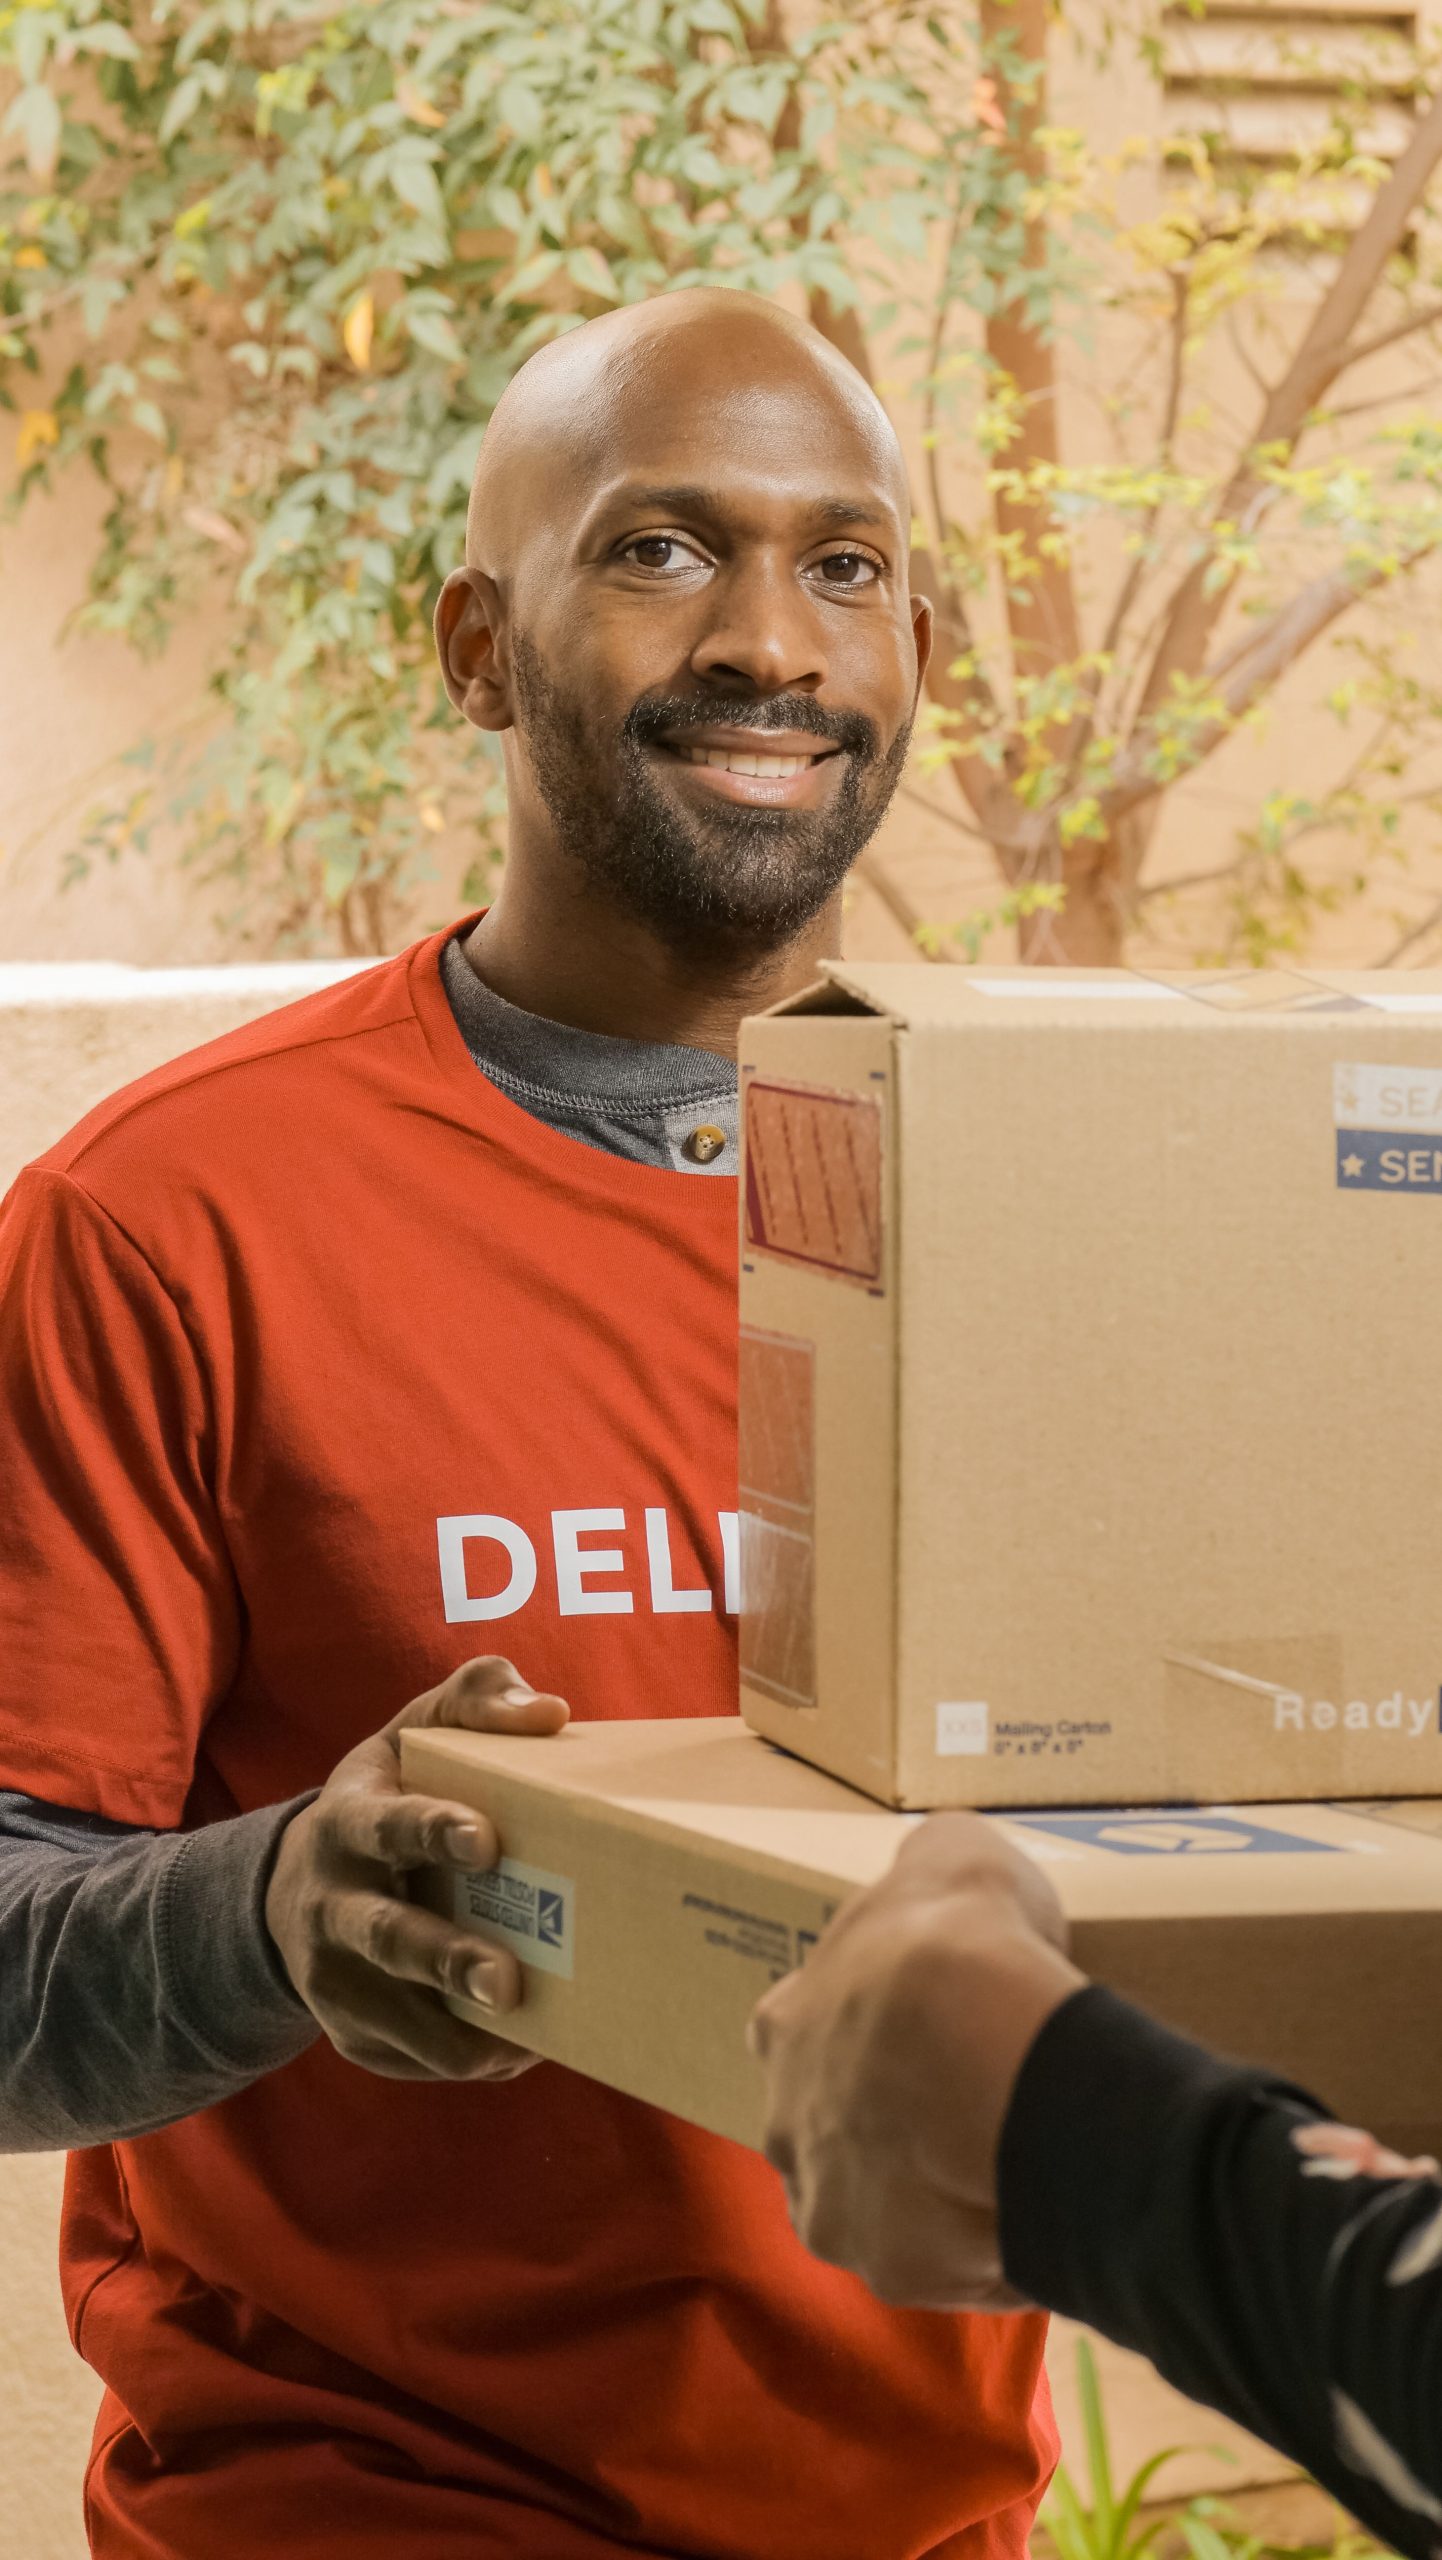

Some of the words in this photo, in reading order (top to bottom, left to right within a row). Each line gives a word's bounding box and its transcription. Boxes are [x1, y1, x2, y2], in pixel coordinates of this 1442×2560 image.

[995, 1722, 1053, 1738] Mailing
[1056, 1719, 1111, 1735] Carton
[1274, 1691, 1433, 1737] Ready
